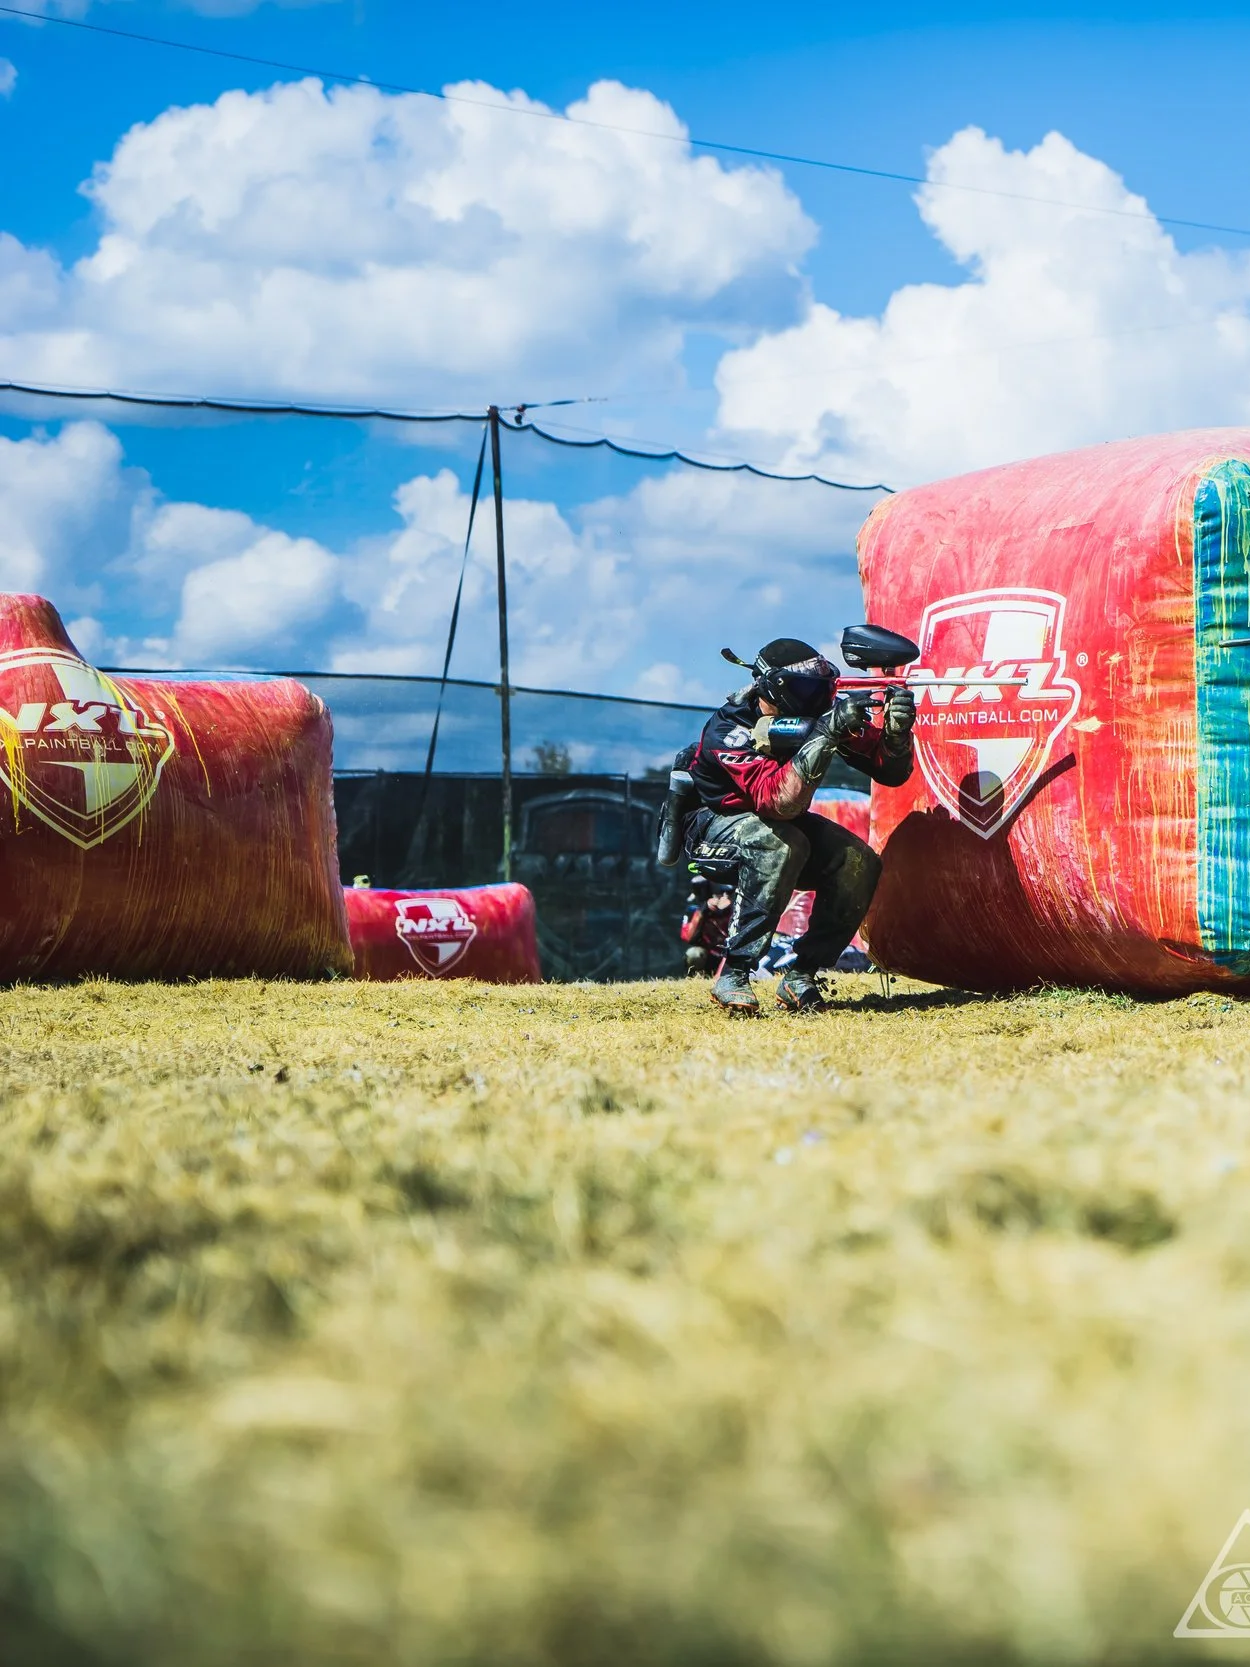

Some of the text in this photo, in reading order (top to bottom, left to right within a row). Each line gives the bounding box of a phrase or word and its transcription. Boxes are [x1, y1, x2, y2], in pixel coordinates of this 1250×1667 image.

[909, 663, 1073, 706] NXL
[0, 702, 167, 738] NXL
[915, 709, 1058, 726] NXLPAINTBALL.COM
[402, 917, 474, 933] NXL
